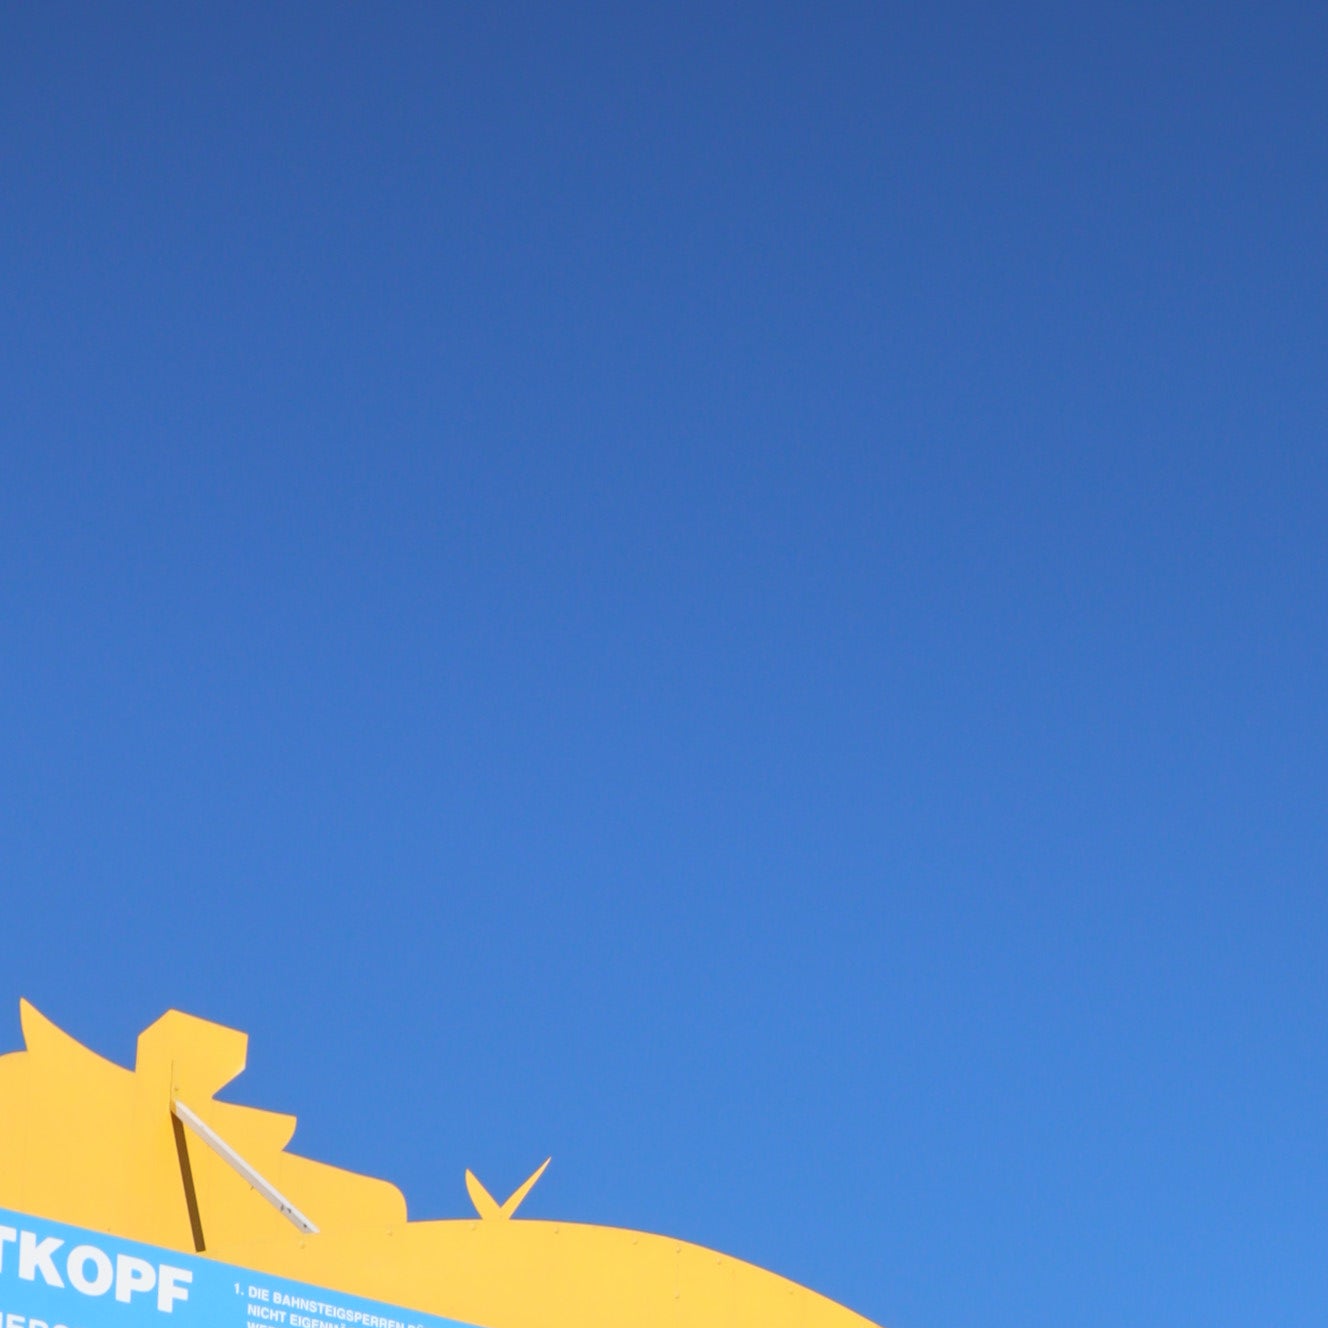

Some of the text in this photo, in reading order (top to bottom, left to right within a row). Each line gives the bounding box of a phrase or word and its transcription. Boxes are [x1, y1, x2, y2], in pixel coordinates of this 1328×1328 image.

[234, 1282, 244, 1296] 1.
[248, 1285, 269, 1302] DIE
[248, 1303, 286, 1323] NICHT
